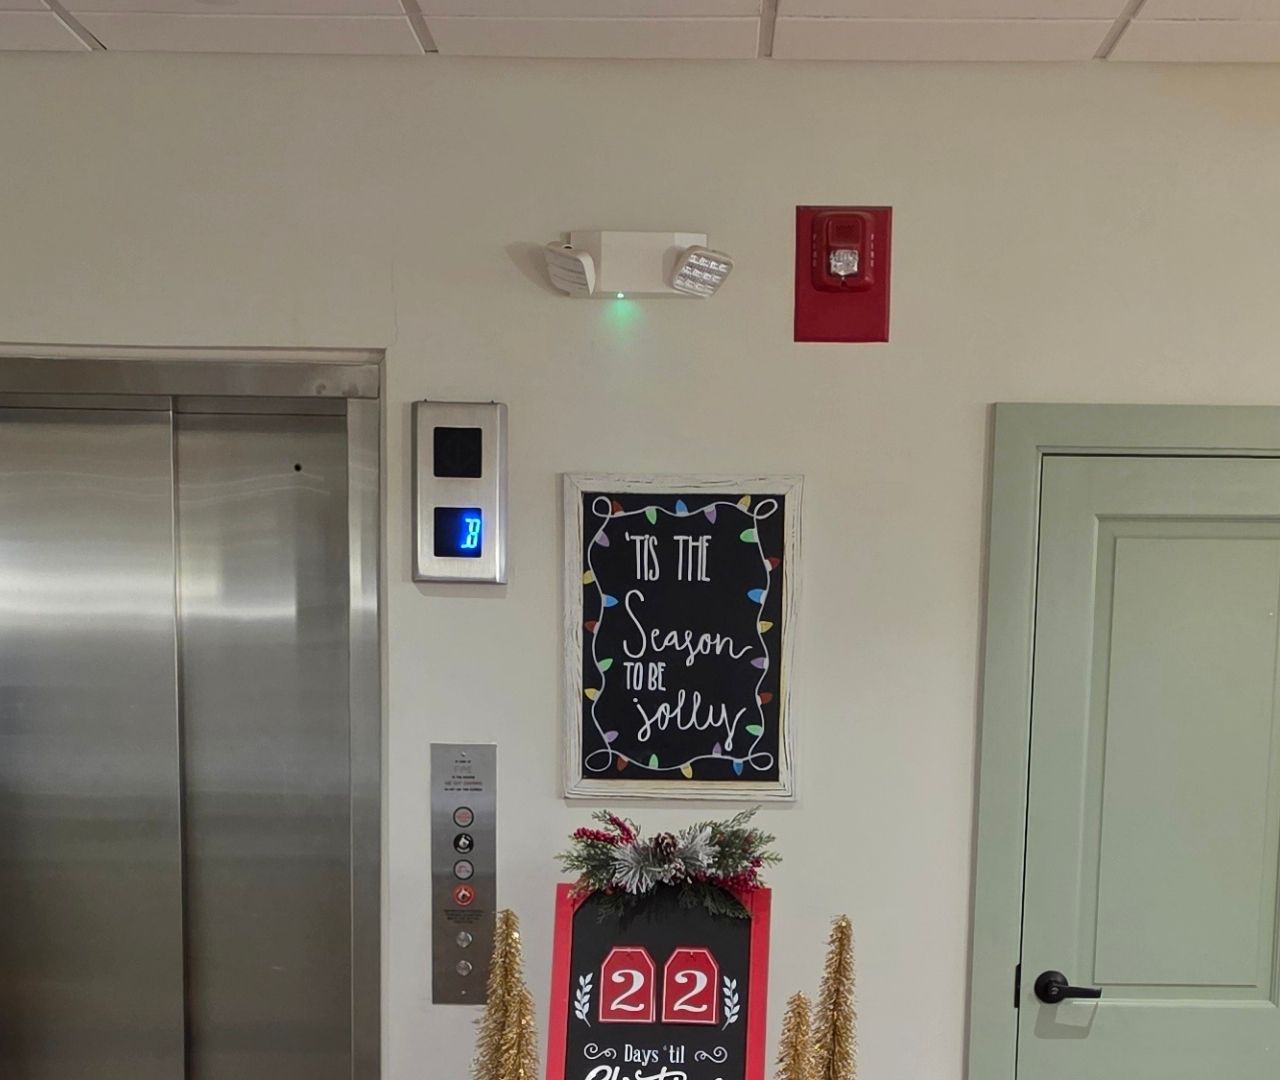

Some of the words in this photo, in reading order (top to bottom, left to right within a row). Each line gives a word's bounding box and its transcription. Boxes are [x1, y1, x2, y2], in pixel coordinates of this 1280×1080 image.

[625, 533, 660, 582] 'TIS
[673, 535, 712, 582] THE
[623, 589, 752, 666] Season
[623, 662, 643, 691] TO
[648, 662, 667, 691] BE
[624, 1043, 659, 1067] Days
